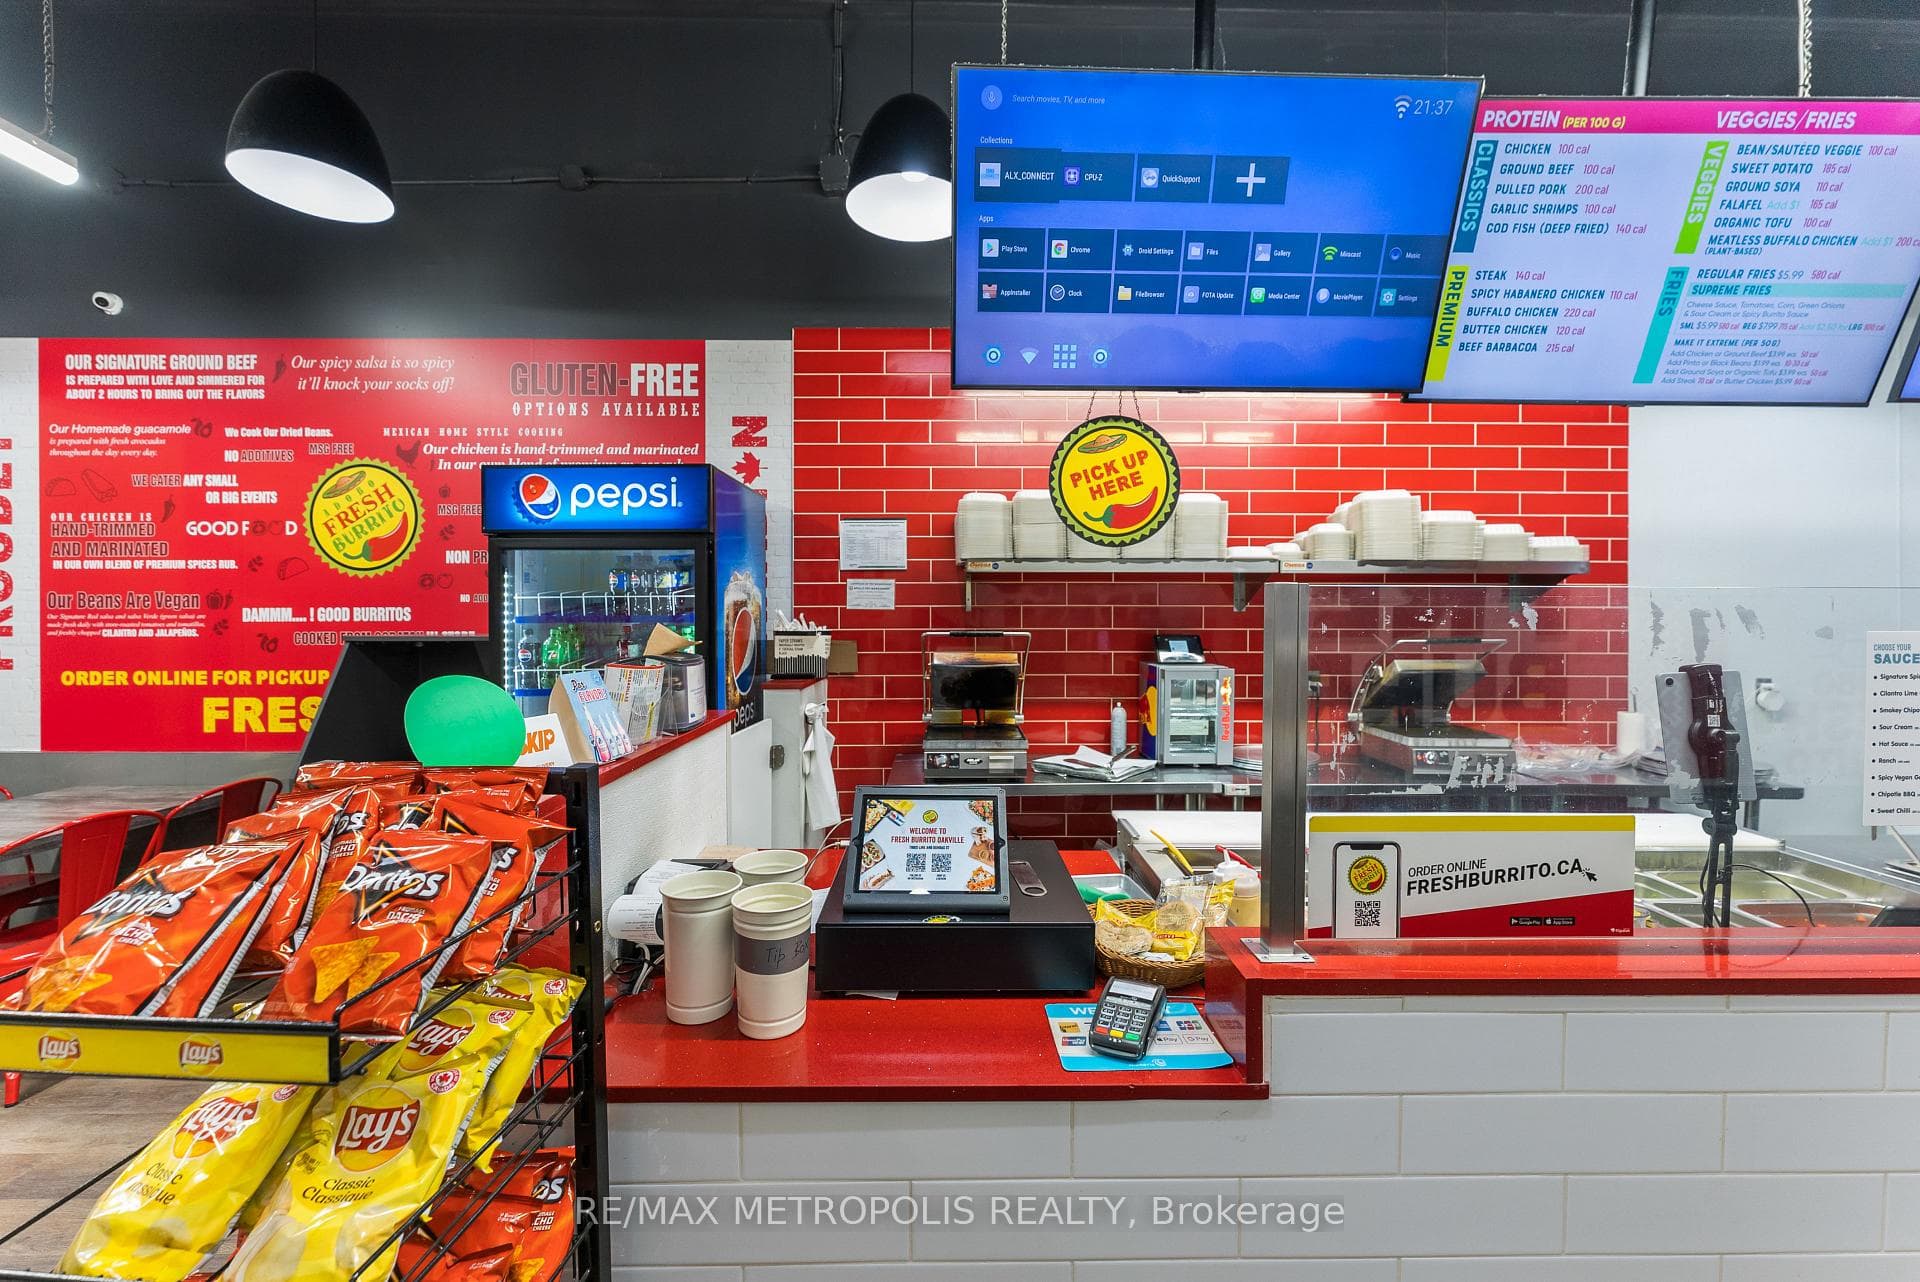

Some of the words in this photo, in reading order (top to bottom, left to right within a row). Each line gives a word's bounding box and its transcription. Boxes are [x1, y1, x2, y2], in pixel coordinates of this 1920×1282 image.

[1413, 100, 1454, 115] 21:37
[1482, 110, 1560, 128] PROTEIN
[1562, 116, 1587, 130] (PER
[1590, 116, 1609, 128] 100
[1611, 116, 1626, 130] G)
[1716, 110, 1858, 131] VEGGIES/FRIES
[980, 136, 1013, 144] Collections
[1504, 143, 1552, 154] CHICKEN
[1737, 144, 1820, 156] BEAN/SAUTEED
[1824, 144, 1863, 156] VEGGIE
[1004, 171, 1055, 181] ALX_CONNECT
[1500, 164, 1544, 175] GROUND
[1548, 164, 1575, 175] BEEF
[1731, 163, 1769, 174] SWEET
[1772, 163, 1813, 174] POTATO
[1162, 174, 1201, 184] QuickSupport
[1687, 145, 1726, 224] VEGGIES
[1725, 181, 1770, 192] GROUND
[1773, 181, 1800, 192] SOYA
[1461, 143, 1494, 232] CLASSICS
[1495, 184, 1534, 195] PULLED
[1538, 184, 1567, 195] PORK
[1490, 203, 1528, 215] GARLIC
[1532, 203, 1579, 215] SHRIMPS
[1719, 199, 1762, 210] FALAFEL
[1486, 222, 1508, 234] COD
[1512, 222, 1535, 234] FISH
[1539, 222, 1571, 234] (DEEP
[1574, 222, 1609, 234] FRIED)
[1714, 217, 1760, 228] ORGANIC
[1764, 217, 1793, 228] TOFU
[1708, 235, 1761, 246] MEATLESS
[1763, 235, 1809, 246] BUFFALO
[1811, 235, 1858, 246] CHICKEN
[1475, 270, 1507, 280] STEAK
[1696, 269, 1743, 280] REGULAR
[1747, 269, 1776, 280] FRIES
[1777, 269, 1804, 280] $5.99
[1471, 289, 1500, 300] SPICY
[1503, 289, 1557, 300] HABANERO
[1560, 289, 1605, 300] CHICKEN
[1658, 270, 1685, 317] FRIES
[1691, 284, 1741, 296] SUPREME
[1742, 284, 1772, 296] FRIES
[1435, 270, 1466, 347] PREMIUM
[1466, 307, 1511, 317] BUFFALO
[1514, 307, 1559, 317] CHICKEN
[1462, 324, 1500, 335] BUTTER
[1504, 324, 1548, 335] CHICKEN
[1458, 342, 1483, 352] BEEF
[1486, 342, 1538, 352] BARBACOA
[65, 354, 92, 370] OUR
[95, 354, 168, 370] SIGNATURE
[169, 354, 223, 370] GROUND
[227, 354, 258, 370] BEEF
[291, 355, 317, 369] Our
[319, 355, 351, 372] spicy
[355, 355, 387, 369] salsa
[391, 355, 401, 369] is
[404, 359, 419, 369] so
[422, 355, 455, 372] spicy
[298, 377, 320, 391] it'll
[323, 377, 360, 391] knock
[362, 380, 392, 393] your
[395, 377, 428, 391] socks
[432, 377, 454, 394] off!
[509, 362, 699, 398] GLUTEN-FREE
[512, 402, 589, 417] OPTIONS
[601, 402, 700, 417] AVAILABLE
[49, 424, 69, 434] Our
[71, 424, 132, 434] Homemade
[134, 424, 191, 436] guacamole
[383, 427, 430, 437] MEXICAN
[439, 427, 472, 437] HOME
[476, 427, 509, 437] STYLE
[518, 427, 564, 437] COOKING
[224, 450, 238, 463] NO
[241, 450, 294, 463] ADDITIVES
[308, 443, 330, 455] MSG
[331, 443, 355, 455] FREE
[423, 443, 448, 455] Our
[450, 443, 498, 455] chicken
[501, 443, 511, 455] is
[514, 443, 604, 455] hand-trimmed
[606, 443, 630, 455] and
[633, 443, 699, 455] marinated
[1069, 459, 1119, 488] PICK
[1121, 449, 1149, 470] UP
[132, 475, 149, 487] WE
[150, 475, 181, 487] CATER
[183, 475, 203, 487] ANY
[205, 475, 238, 487] SMALL
[1088, 471, 1144, 501] HERE
[205, 491, 220, 504] OR
[222, 491, 240, 504] BIG
[241, 491, 278, 504] EVENTS
[570, 476, 678, 516] pepsi
[322, 483, 394, 537] FRESH
[50, 522, 155, 537] HAND-TRIMMED
[186, 520, 239, 536] GOOD
[332, 498, 405, 552] BURRITO
[51, 541, 82, 557] AND
[85, 541, 169, 557] MARINATED
[47, 591, 72, 609] Our
[76, 591, 122, 609] Beans
[125, 591, 150, 609] Are
[155, 591, 200, 611] Vegan
[317, 607, 351, 622] GOOD
[353, 607, 412, 622] BURRITOS
[293, 631, 337, 645] COOKED
[61, 669, 129, 686] ORDER
[132, 669, 208, 686] ONLINE
[211, 669, 252, 686] FOR
[256, 669, 331, 686] PICKUP
[1220, 725, 1230, 742] Red
[520, 728, 556, 756] KIP
[909, 827, 938, 835] WELCOME
[939, 827, 947, 835] TO
[891, 836, 910, 844] FRESH
[911, 836, 936, 844] BURRITO
[937, 836, 965, 844] OAKVILLE
[1408, 864, 1445, 878] ORDER
[1447, 858, 1487, 874] ONLINE
[339, 862, 449, 898] Doritos
[1406, 858, 1583, 897] FRESHBURRITO.CA
[81, 886, 197, 918] Doritos
[766, 946, 786, 968] Tip
[39, 1037, 79, 1058] Lay's
[183, 1040, 221, 1063] Lay's
[184, 1097, 254, 1142] Lay's
[339, 1103, 418, 1154] Lay's
[323, 1176, 376, 1190] Classic
[302, 1186, 374, 1205] Classique
